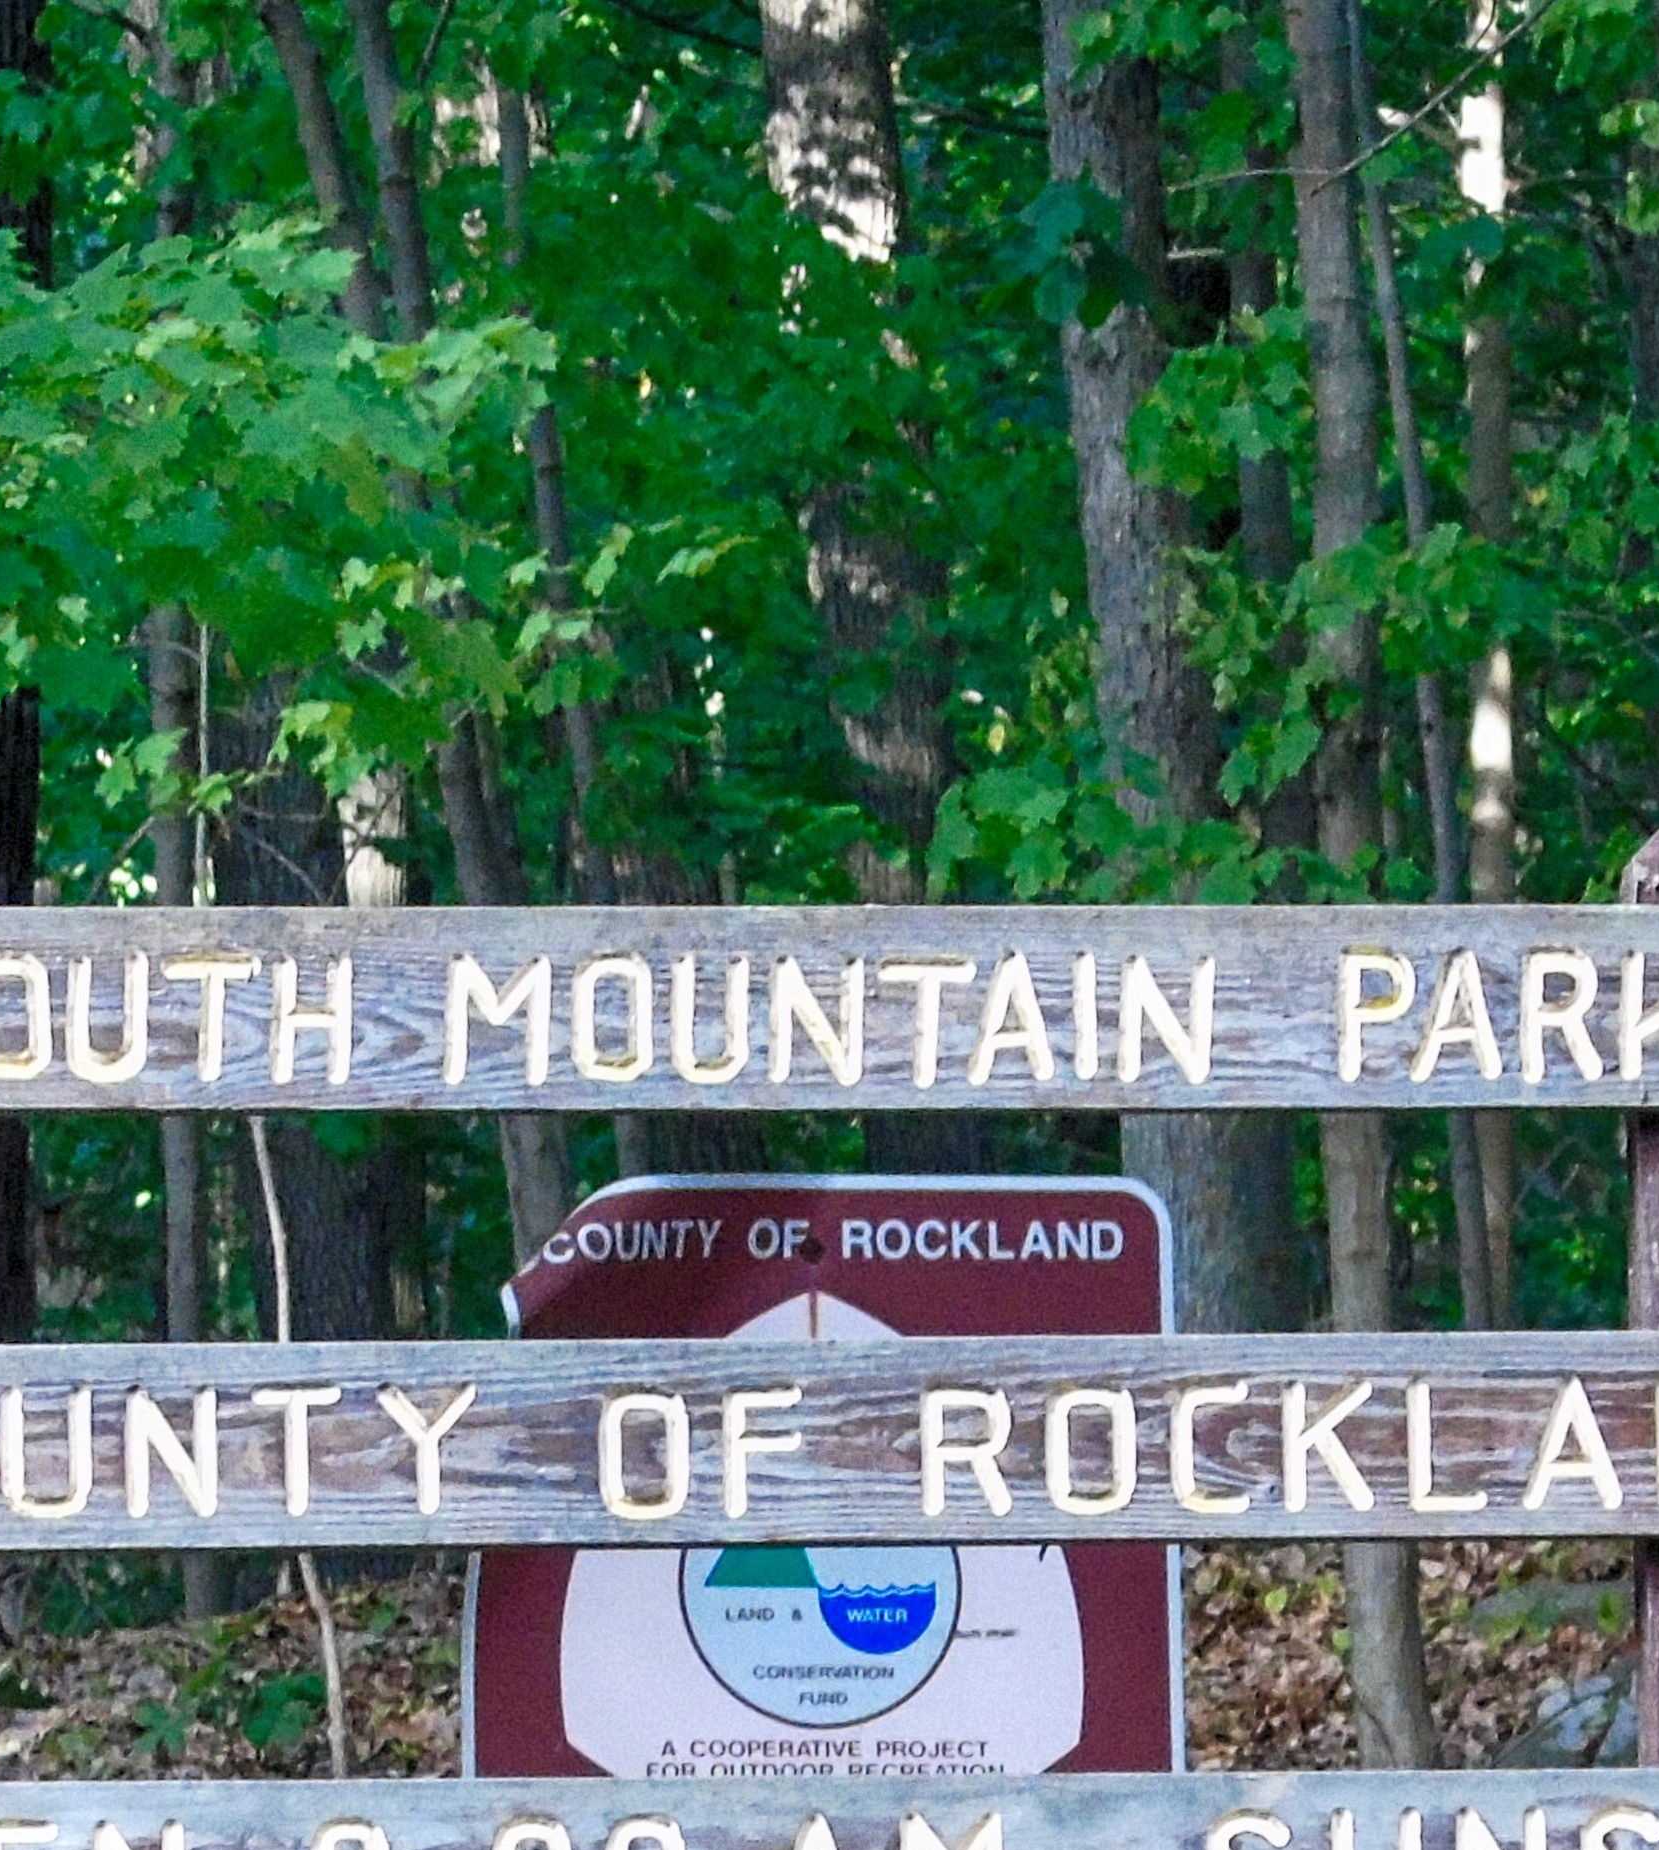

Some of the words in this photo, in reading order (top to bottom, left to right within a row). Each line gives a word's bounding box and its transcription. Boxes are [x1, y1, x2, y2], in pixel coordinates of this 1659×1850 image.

[442, 950, 1215, 1087] MOUNTAIN
[542, 1218, 721, 1265] COUNTY
[747, 1217, 810, 1259] OF
[842, 1217, 1124, 1261] ROCKLAND
[599, 1384, 804, 1521] OF
[725, 1607, 775, 1622] LAND
[847, 1607, 908, 1622] WATER
[753, 1664, 895, 1680] CONSERVATION
[799, 1691, 848, 1706] FUND
[661, 1740, 676, 1757] A
[689, 1739, 862, 1758] COOPERATIVE
[876, 1739, 988, 1758] PROJECT
[646, 1762, 696, 1777] FOR
[710, 1762, 834, 1776] OUTDOOR
[848, 1762, 1005, 1776] RECREATION
